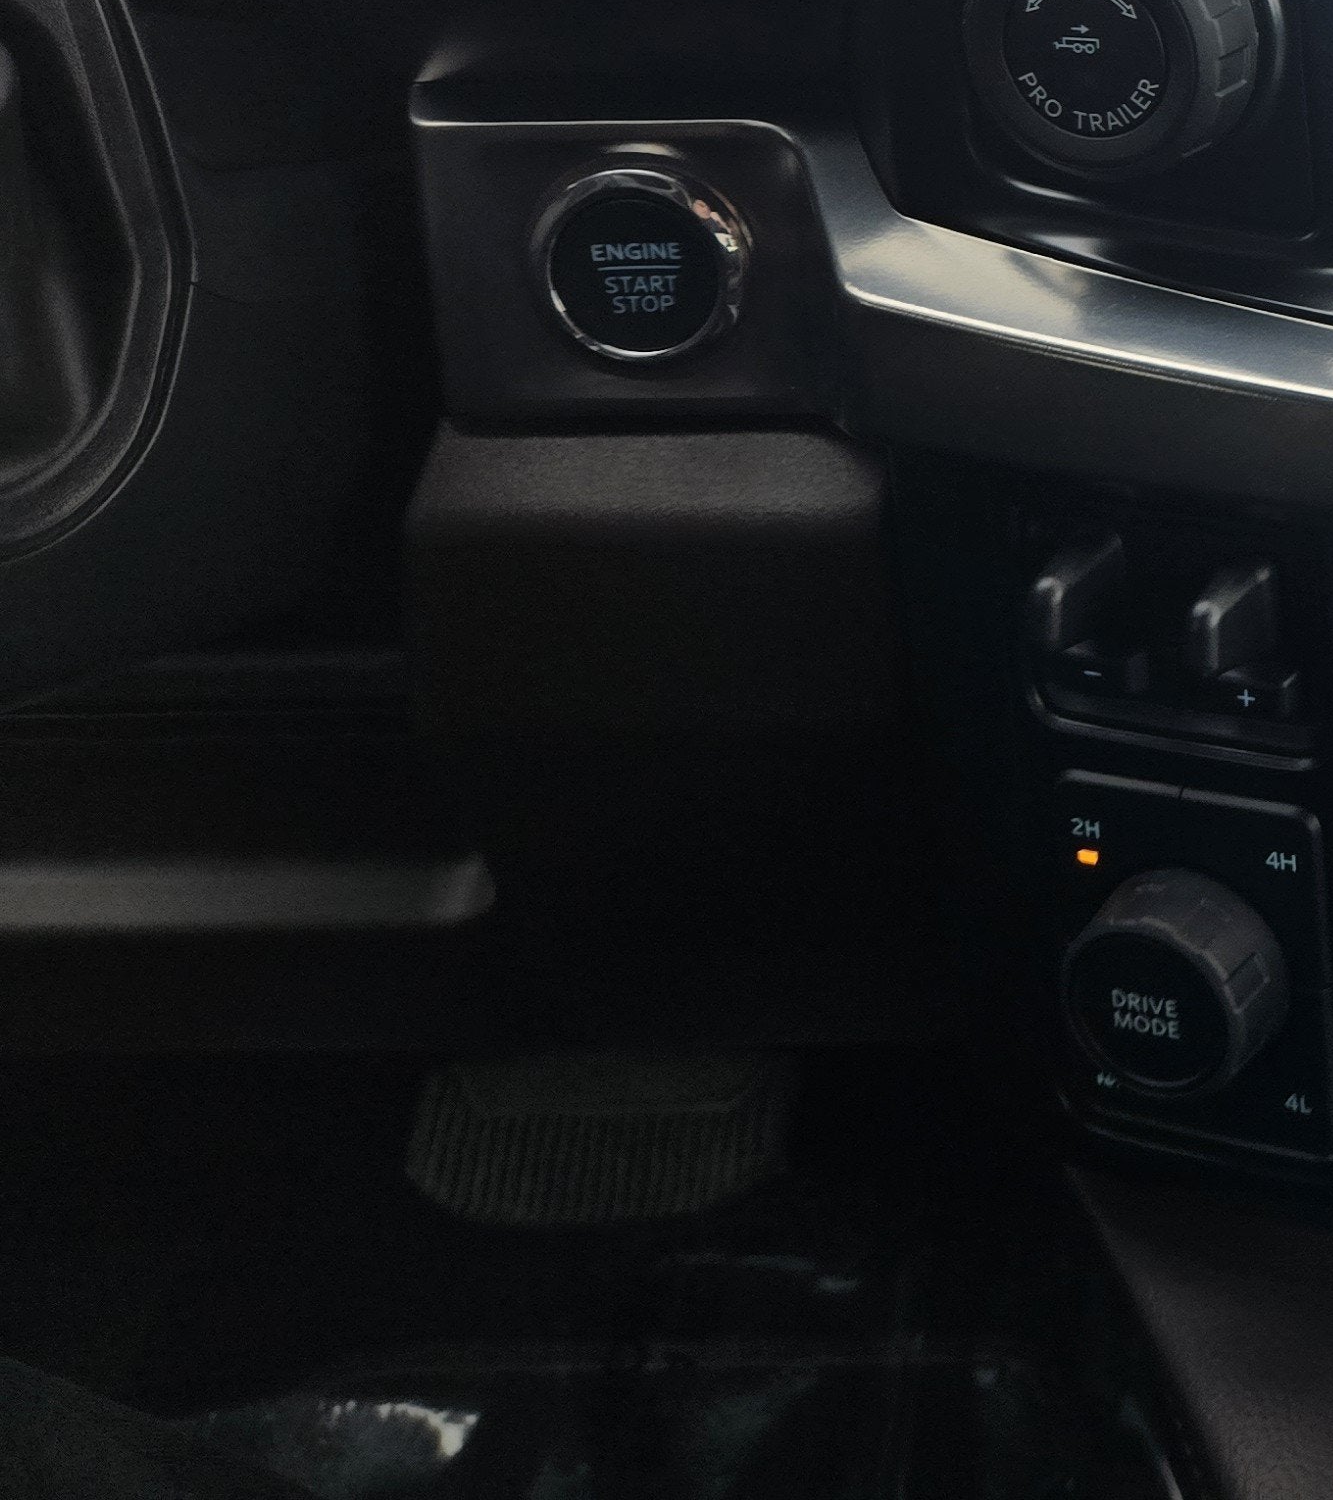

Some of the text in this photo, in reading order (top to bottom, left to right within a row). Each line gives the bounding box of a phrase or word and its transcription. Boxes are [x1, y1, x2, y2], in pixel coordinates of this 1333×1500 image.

[1018, 72, 1160, 132] PRO TRAILER
[590, 242, 683, 262] ENGINE
[605, 275, 676, 294] START
[612, 295, 674, 314] STOP
[1071, 818, 1100, 838] 2H
[1266, 852, 1296, 872] 4H
[1110, 988, 1180, 1018] DRIVE
[1113, 1010, 1182, 1041] MODE
